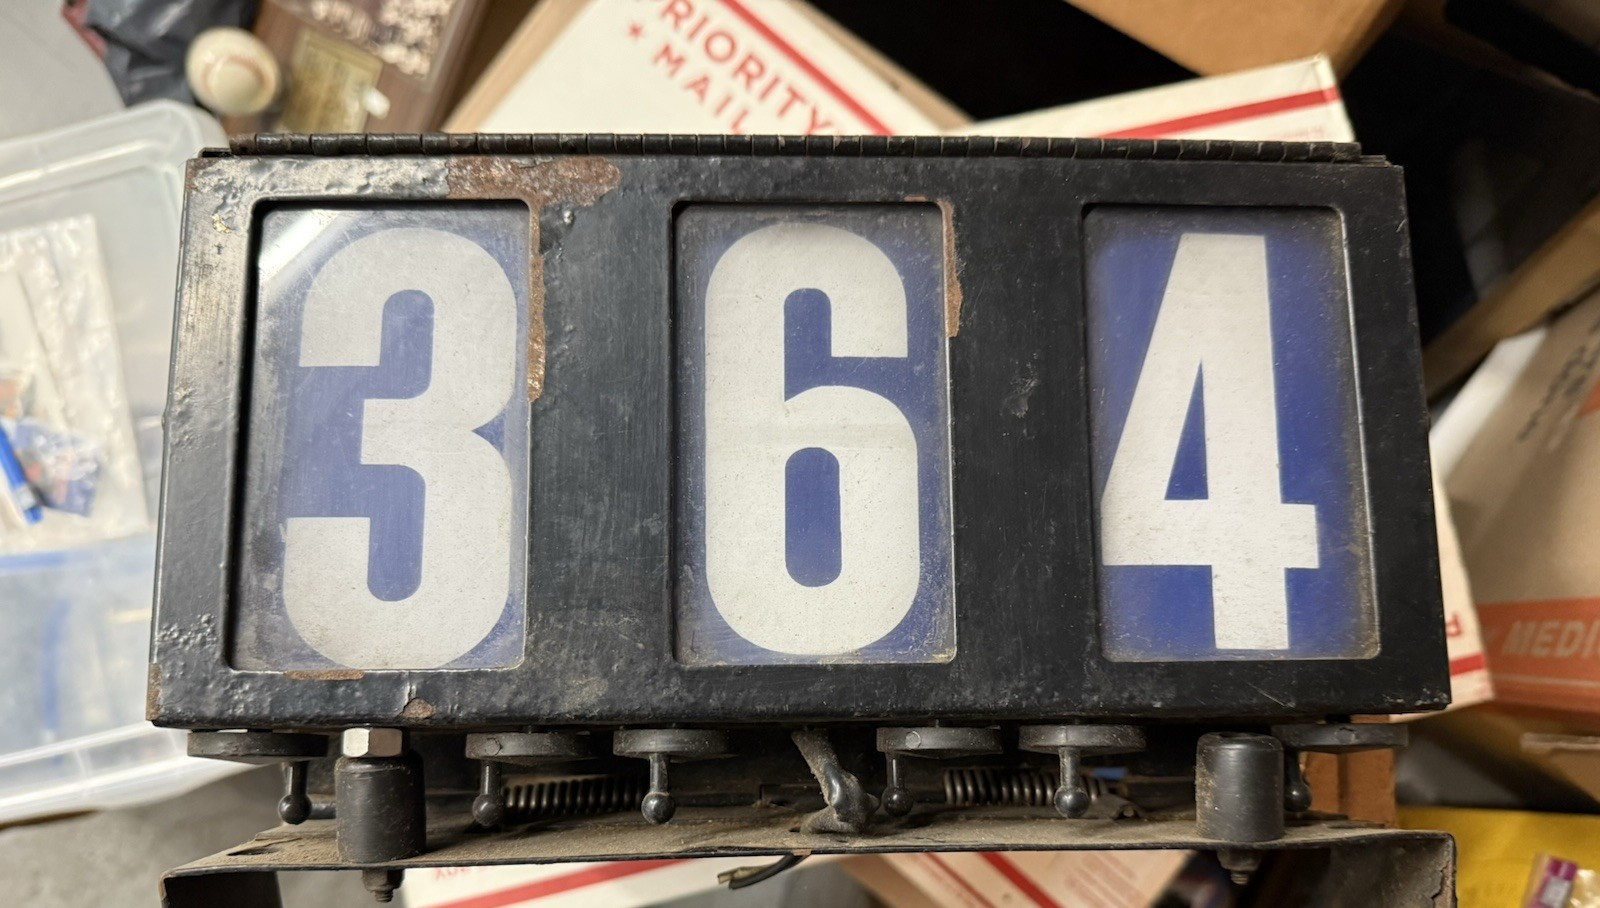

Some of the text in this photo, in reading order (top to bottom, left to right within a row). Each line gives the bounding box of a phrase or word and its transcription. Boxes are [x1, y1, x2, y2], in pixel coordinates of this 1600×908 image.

[653, 44, 750, 135] MAIL
[655, 0, 833, 135] RIORITY
[1502, 619, 1600, 659] MEDI
